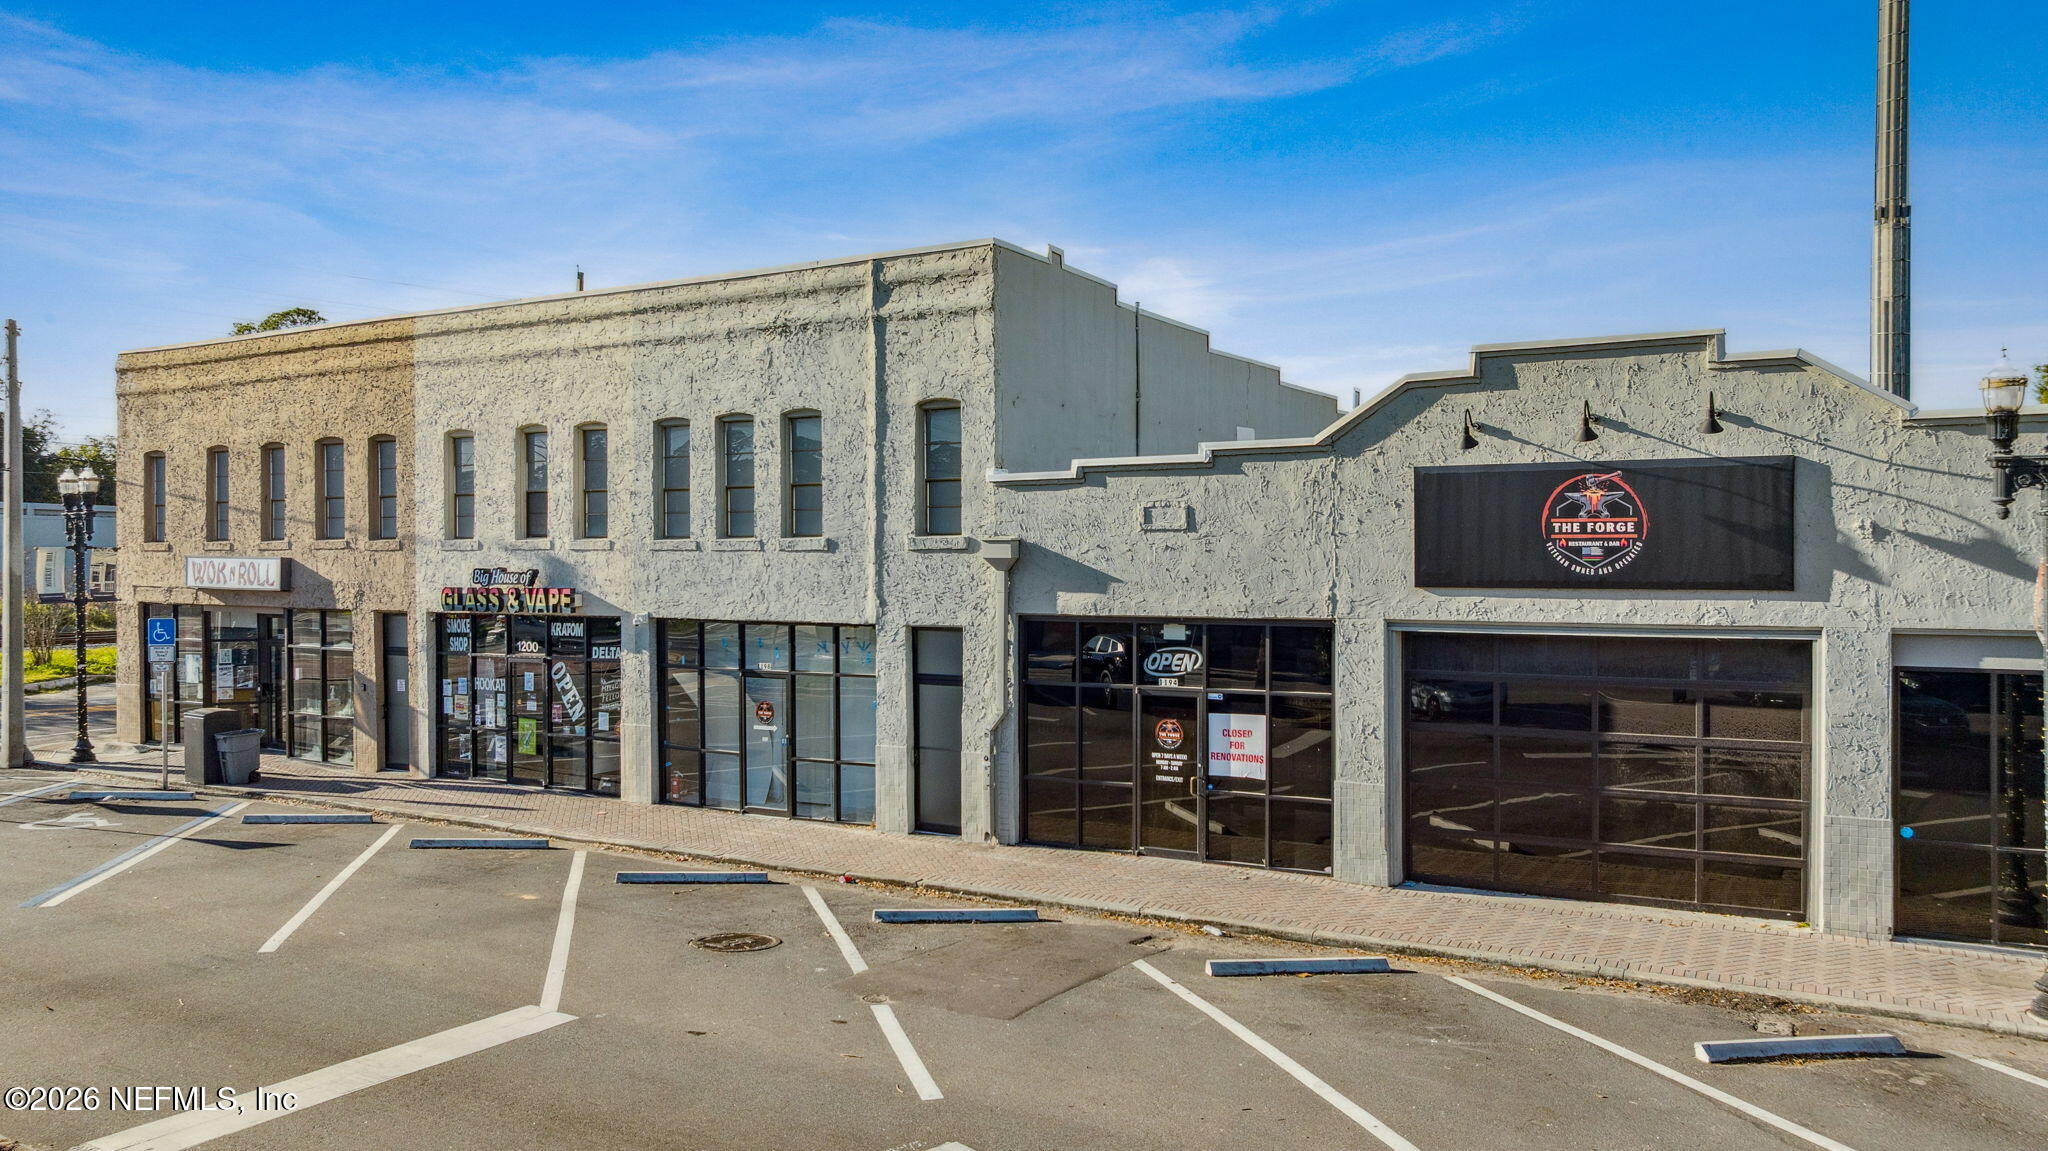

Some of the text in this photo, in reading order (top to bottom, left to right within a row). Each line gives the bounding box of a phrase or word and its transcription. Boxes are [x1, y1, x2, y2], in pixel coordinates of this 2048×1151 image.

[1552, 522, 1635, 533] THE FORGE
[1546, 541, 1643, 576] VETERAN OWNED AND OPERATED
[191, 560, 227, 585] WOK
[238, 561, 275, 586] ROLL
[473, 568, 533, 585] Big House of
[442, 587, 572, 613] GLASS & VAPE
[446, 618, 471, 633] SMOKE
[551, 622, 584, 637] KRATOM
[449, 636, 469, 652] SHOP
[517, 641, 539, 653] 1200
[592, 646, 621, 659] DELTA
[1147, 653, 1197, 672] OPEN
[475, 677, 506, 692] HOOKAH
[551, 661, 586, 722] OPEN
[1222, 728, 1253, 738] CLOSED
[1229, 741, 1245, 750] FOR
[1210, 752, 1264, 764] RENOVATIONS
